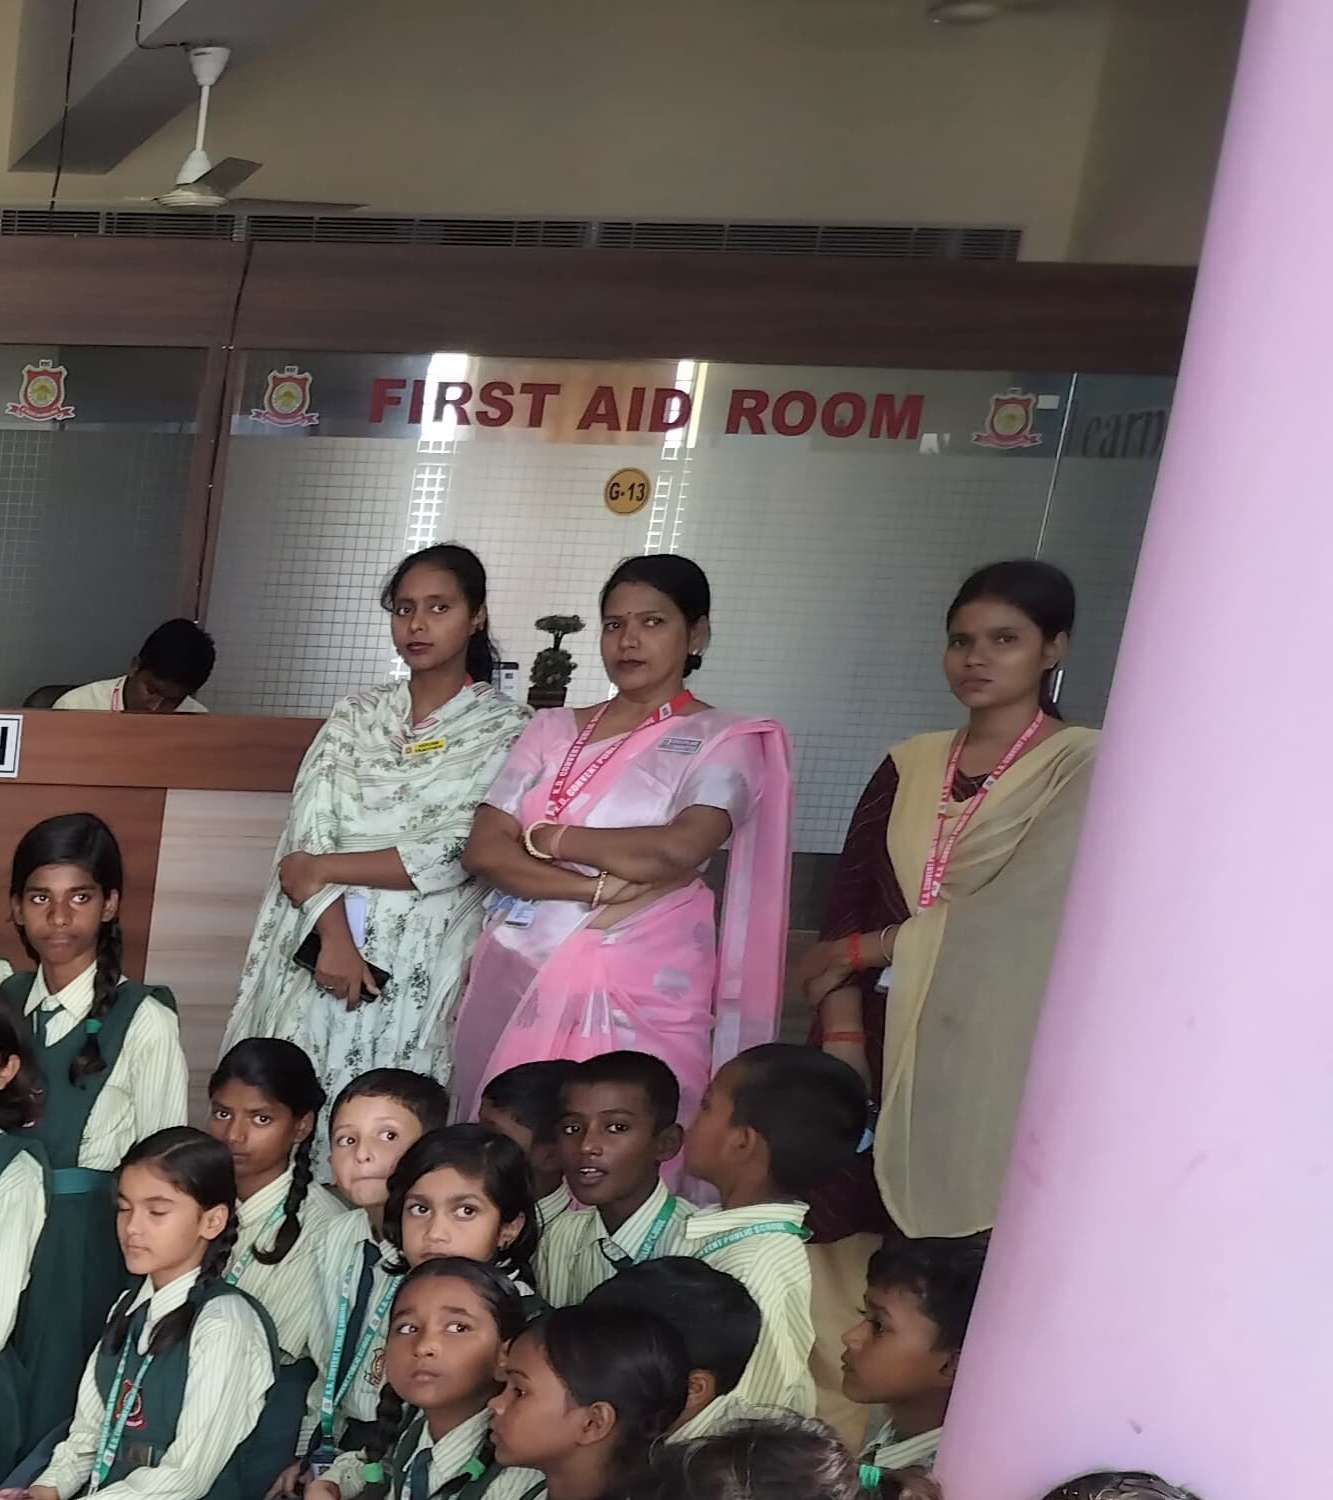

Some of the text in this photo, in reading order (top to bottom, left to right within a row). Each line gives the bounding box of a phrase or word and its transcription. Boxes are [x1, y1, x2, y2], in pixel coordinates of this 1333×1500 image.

[368, 377, 926, 440] FIRST AID ROOM
[608, 480, 647, 503] G-13
[723, 1226, 754, 1245] PUBLIC
